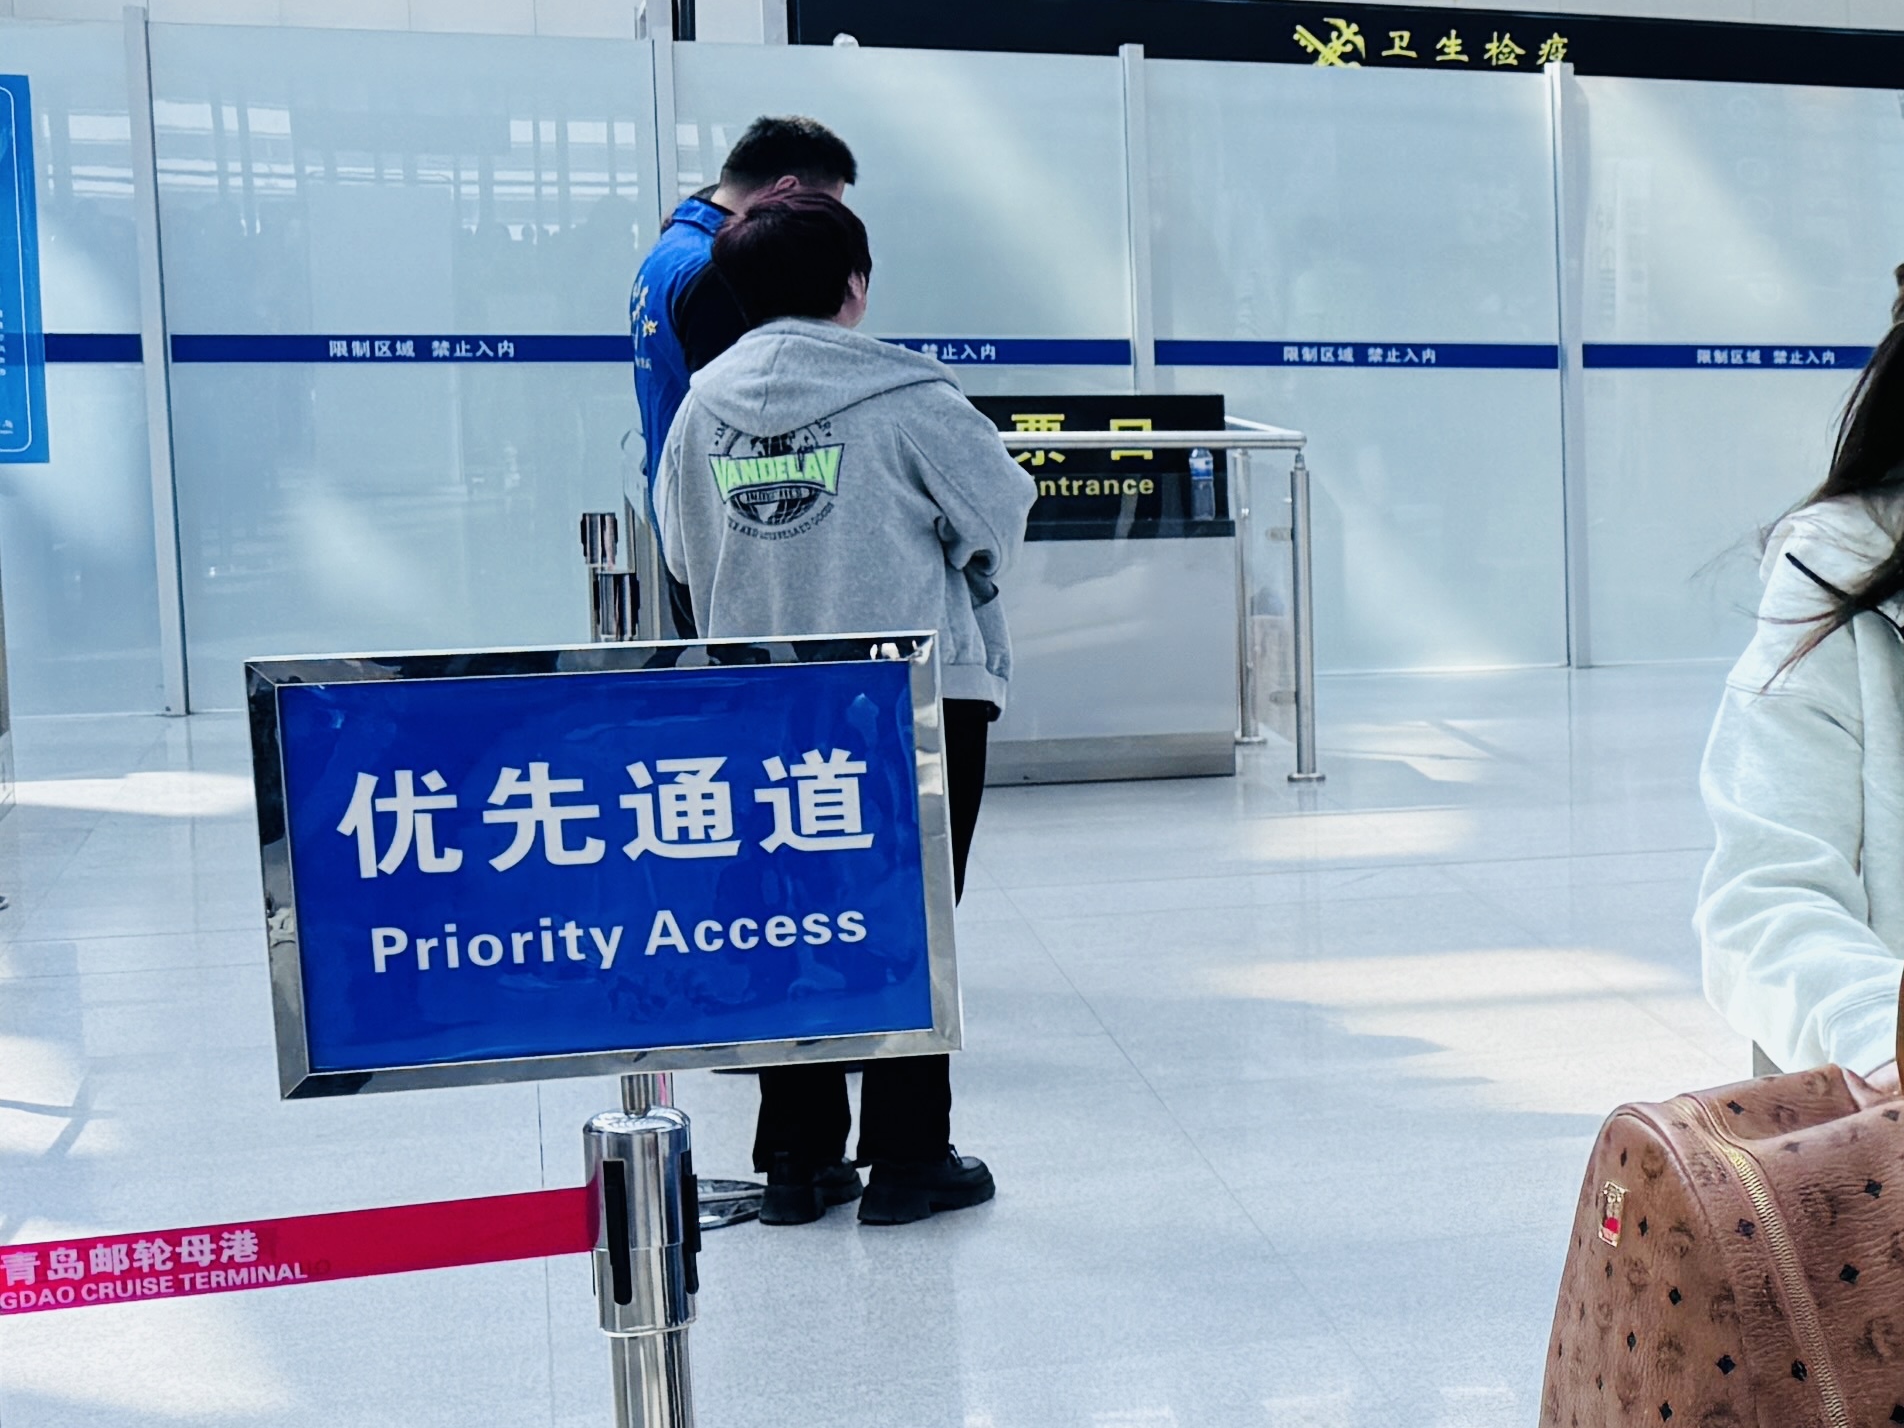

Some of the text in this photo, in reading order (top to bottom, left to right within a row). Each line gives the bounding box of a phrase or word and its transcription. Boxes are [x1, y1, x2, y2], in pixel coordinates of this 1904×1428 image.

[1380, 29, 1569, 66] 卫生检疫
[328, 339, 515, 359] 限制区域 禁止入内
[1283, 346, 1437, 364] 限制区域 禁止入内
[1696, 348, 1836, 365] 限制区域 禁止入内
[709, 445, 843, 503] VANDELAY
[1034, 475, 1154, 497] ntrance
[337, 747, 875, 879] 优先通道
[370, 909, 868, 974] Priority Access
[1, 1228, 260, 1287] 青岛邮轮母港
[80, 1276, 175, 1302] CRUISE
[178, 1262, 308, 1292] TERMINAL
